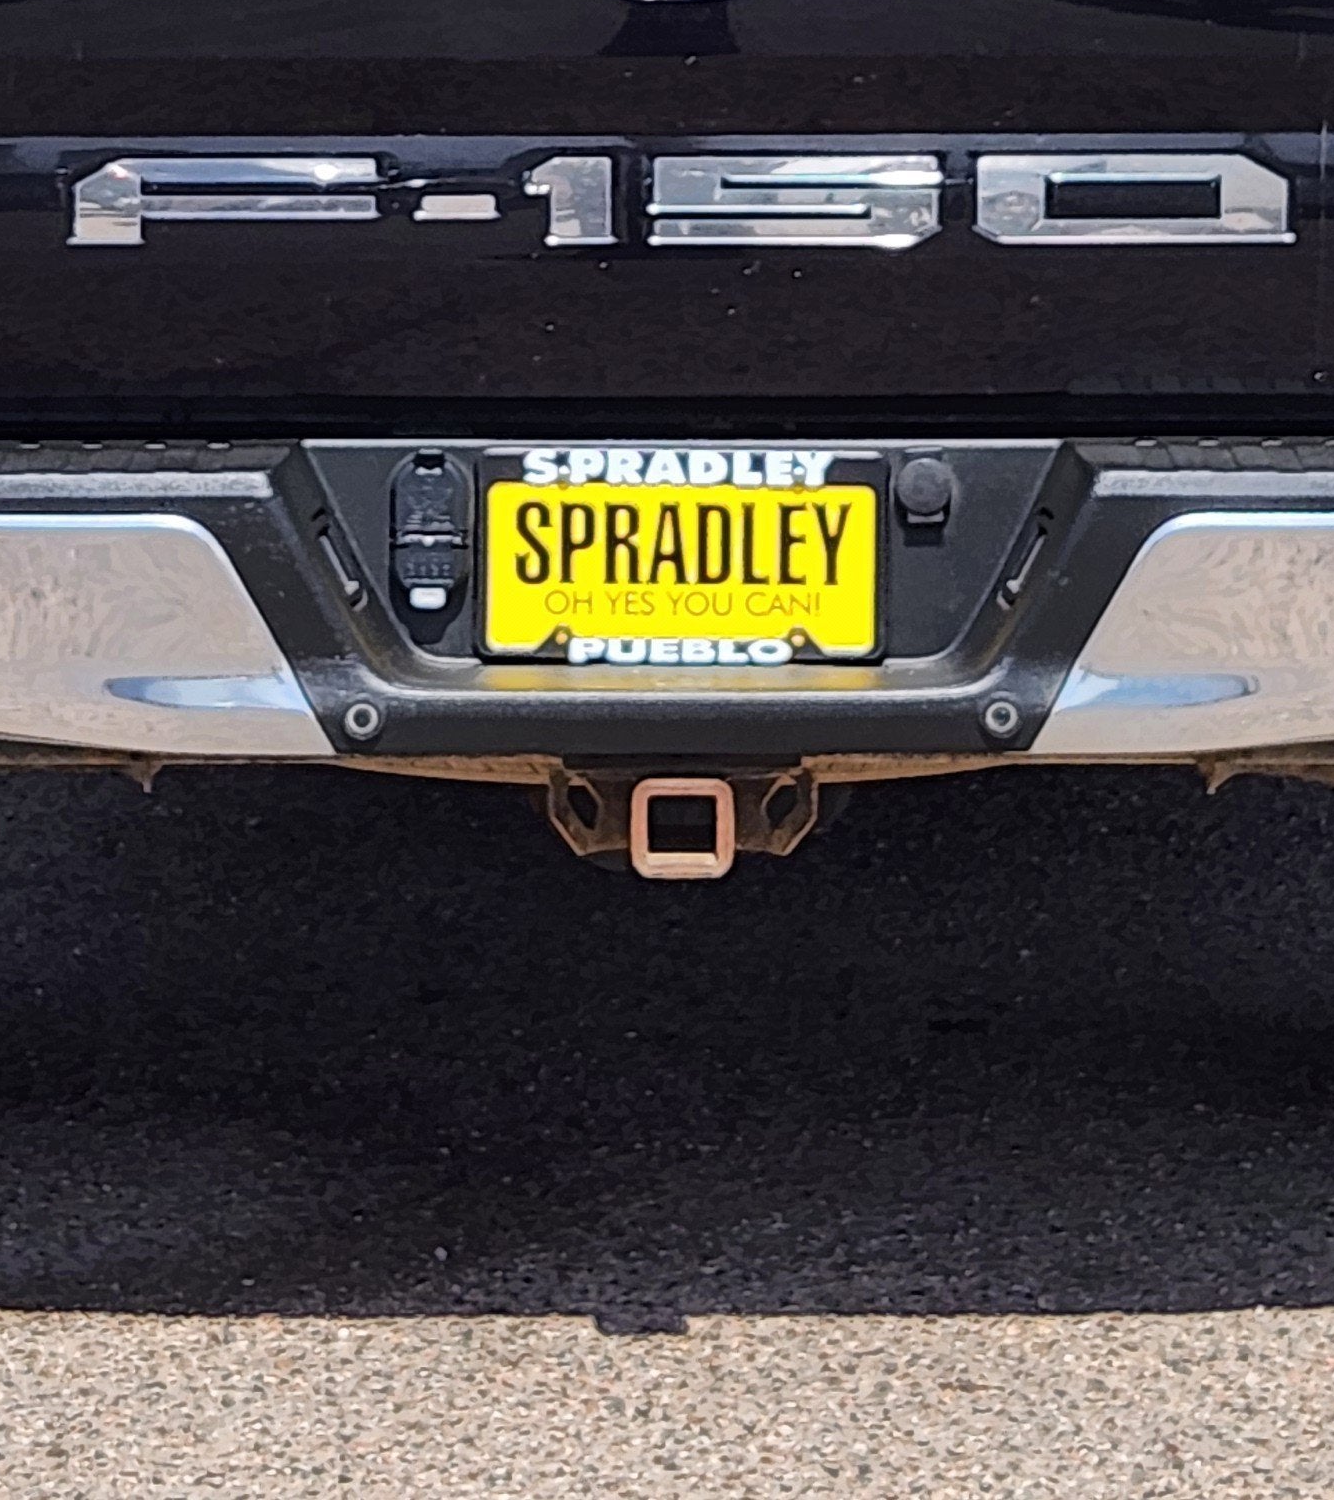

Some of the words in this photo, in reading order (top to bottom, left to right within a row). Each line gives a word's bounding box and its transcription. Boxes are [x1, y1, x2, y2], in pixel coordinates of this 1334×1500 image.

[66, 155, 1297, 248] F-150
[523, 449, 835, 486] SPRADLEY
[515, 501, 852, 585] SPRADLEY
[544, 590, 593, 616] OH
[605, 590, 656, 617] YES
[665, 590, 733, 618] YOU
[744, 591, 821, 618] CAN!
[568, 637, 793, 665] PUEBLO
